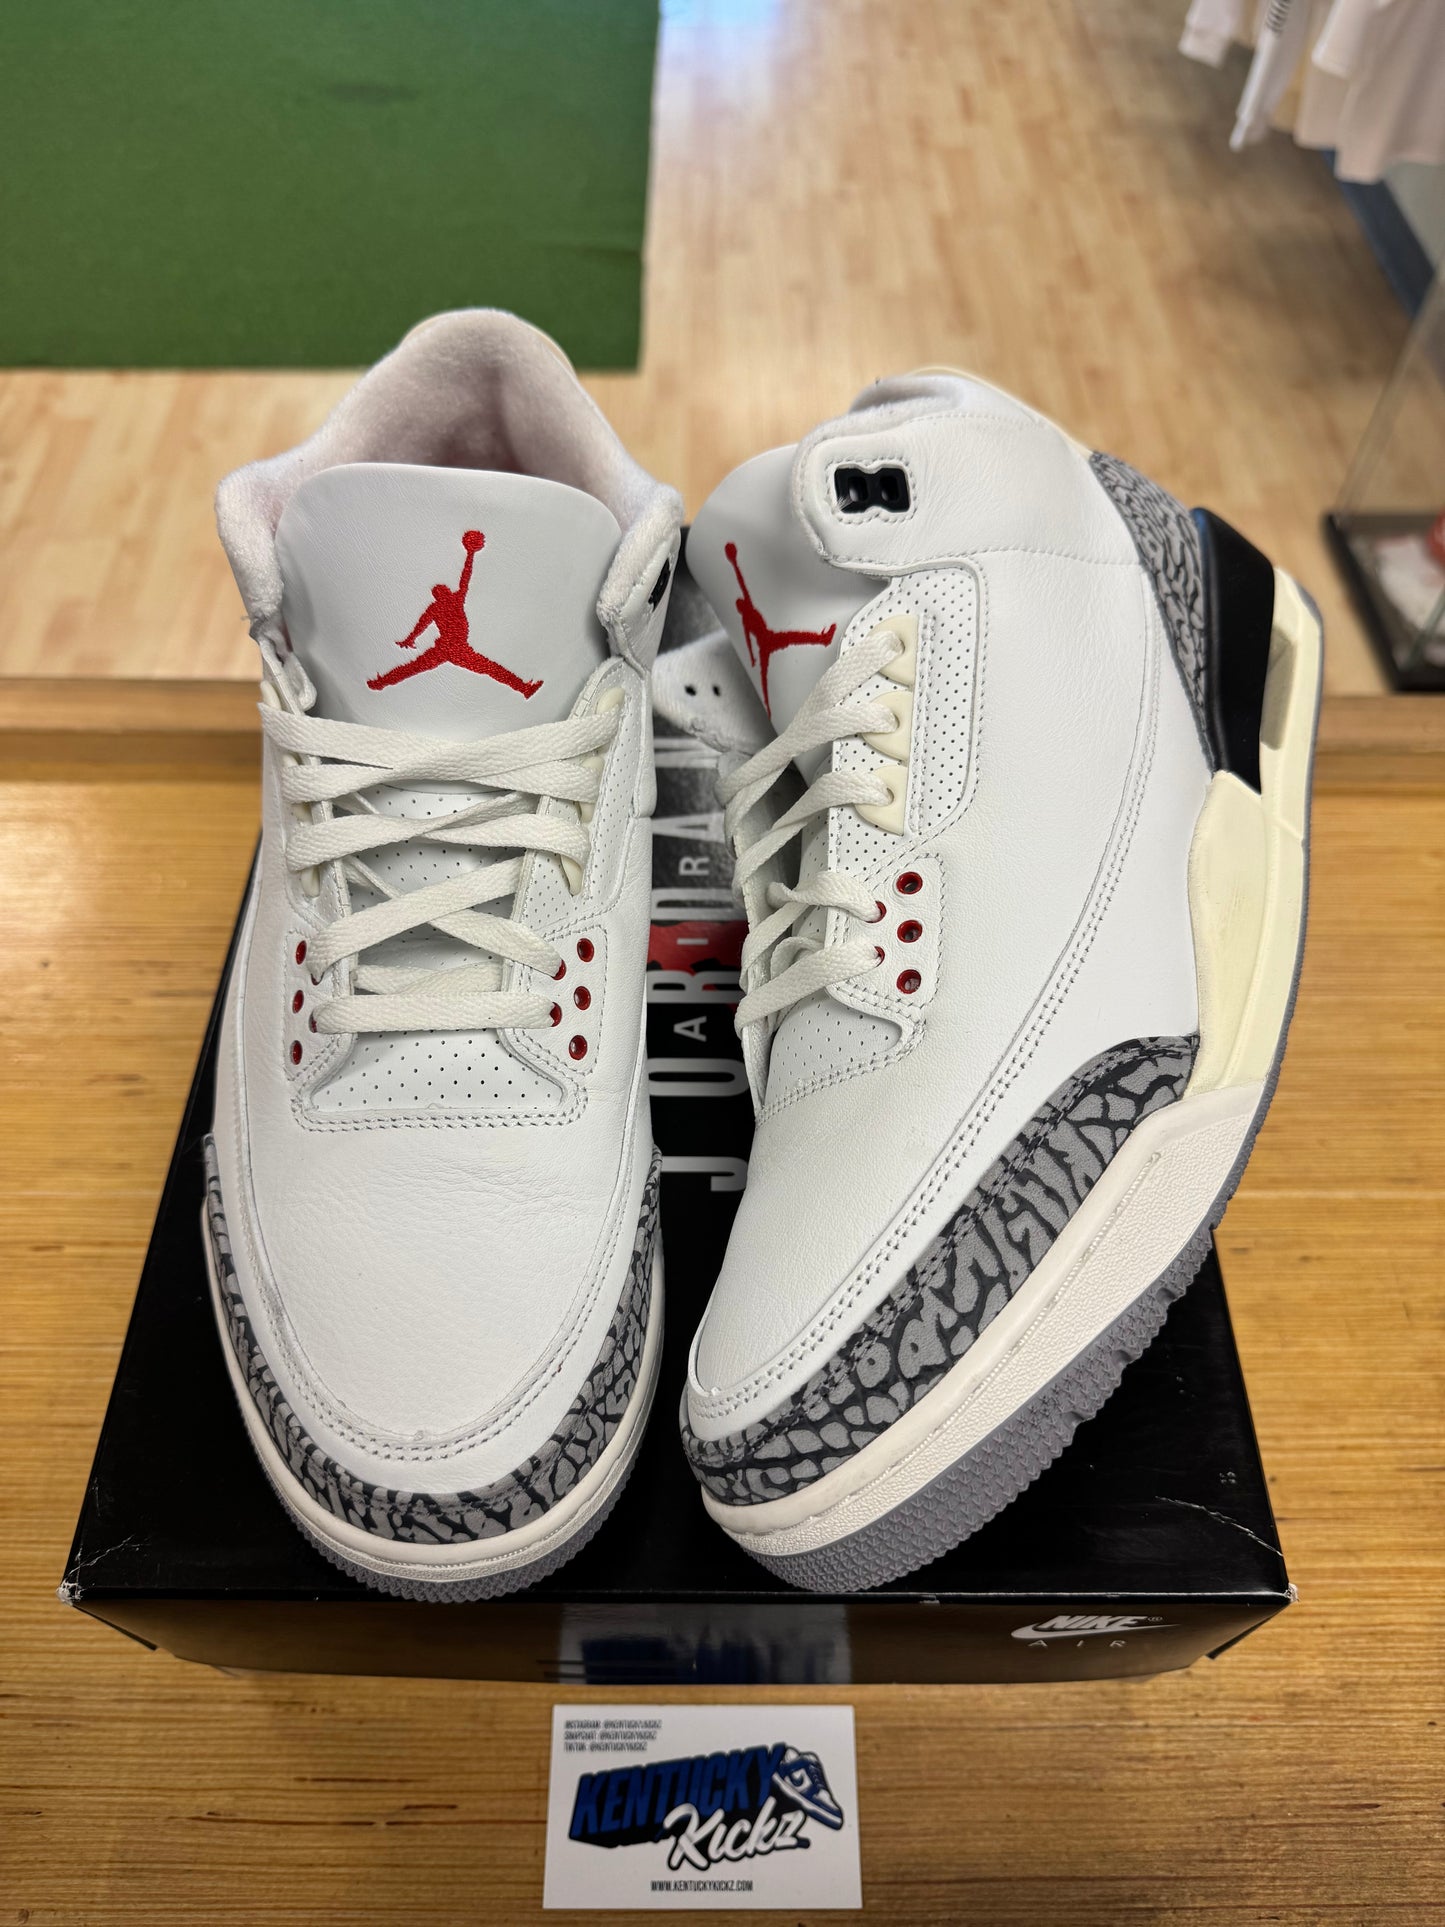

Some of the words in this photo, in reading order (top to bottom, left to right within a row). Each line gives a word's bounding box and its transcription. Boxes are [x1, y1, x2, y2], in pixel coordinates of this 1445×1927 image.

[1028, 1639, 1127, 1647] AIR
[1038, 1615, 1149, 1629] NIKE
[569, 1742, 787, 1843] KENTUCKY
[664, 1796, 808, 1871] Kickz
